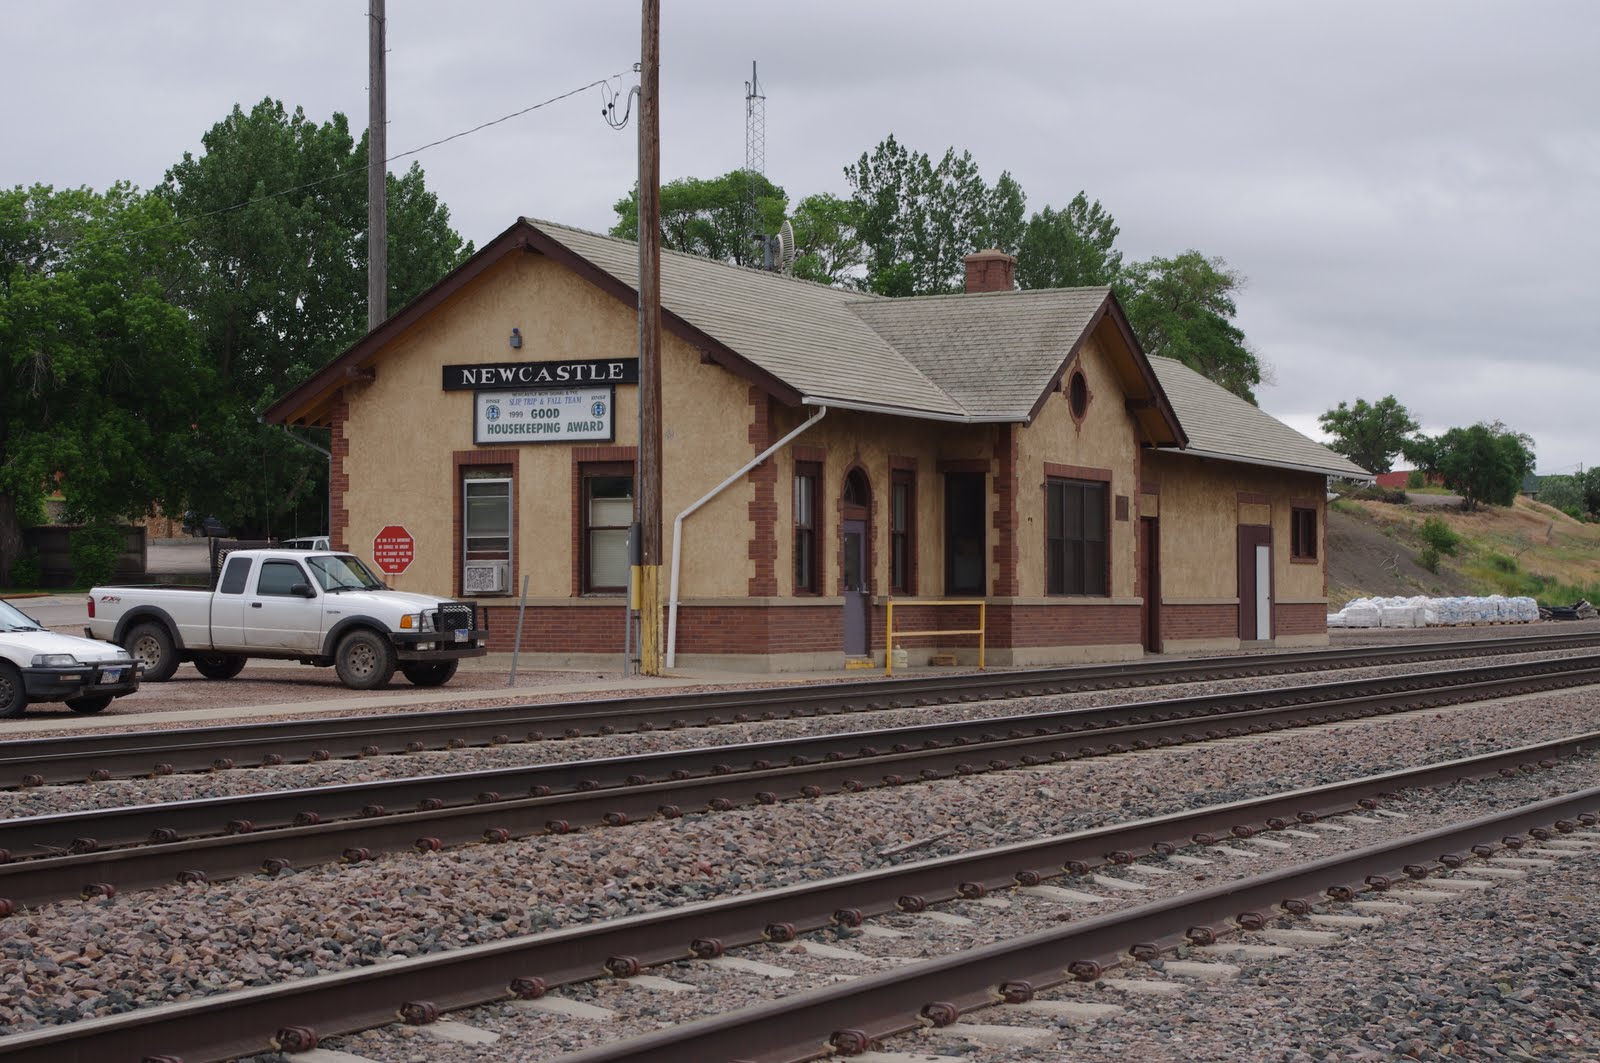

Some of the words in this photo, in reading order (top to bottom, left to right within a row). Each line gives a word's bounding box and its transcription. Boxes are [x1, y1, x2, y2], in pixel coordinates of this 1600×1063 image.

[461, 363, 624, 385] NEWCASTLE
[564, 396, 582, 404] TEAM
[531, 408, 560, 419] GOOD
[487, 422, 561, 435] HOUSEKEEPING
[567, 420, 604, 433] AWARD
